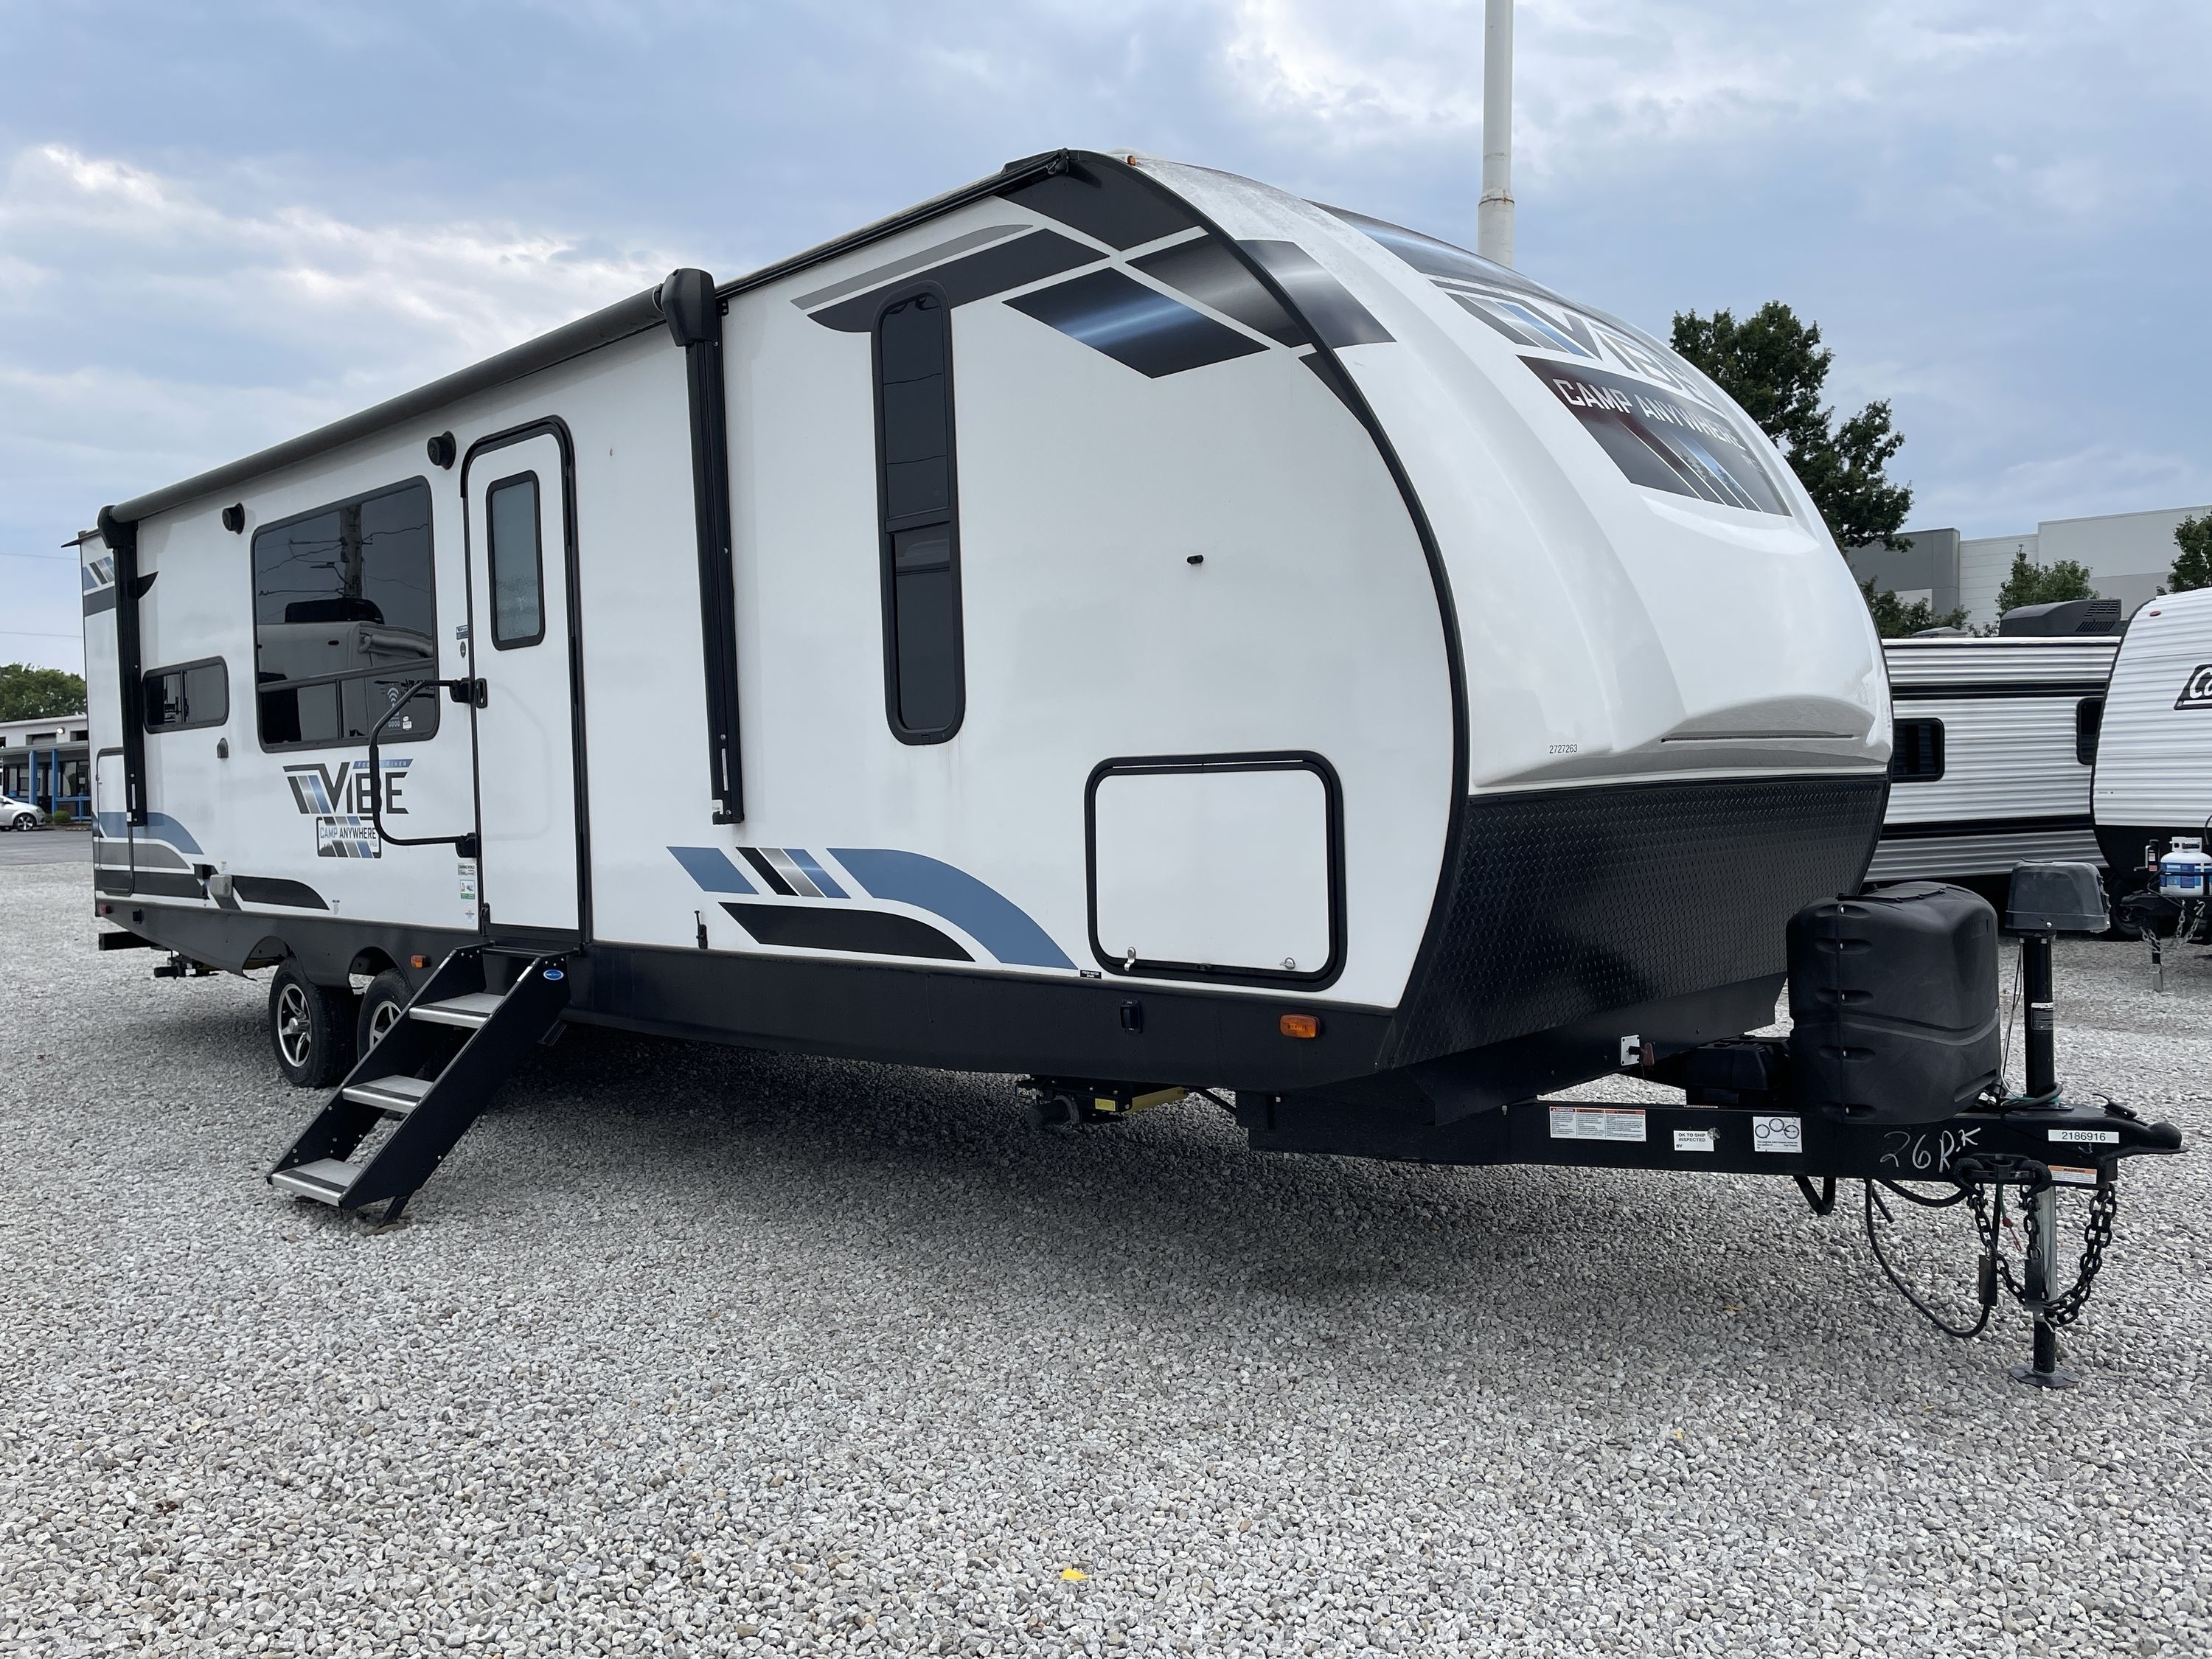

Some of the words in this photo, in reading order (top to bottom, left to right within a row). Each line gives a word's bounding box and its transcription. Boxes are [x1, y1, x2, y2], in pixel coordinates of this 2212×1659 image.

[1552, 378, 1632, 414] CAMP
[1634, 394, 1746, 451] ANYWHERE
[1549, 744, 1578, 754] 2727263
[283, 762, 410, 815] VIBE
[319, 827, 338, 838] CAMP
[339, 827, 377, 839] ANYWHERE
[2062, 1131, 2107, 1141] 2186916
